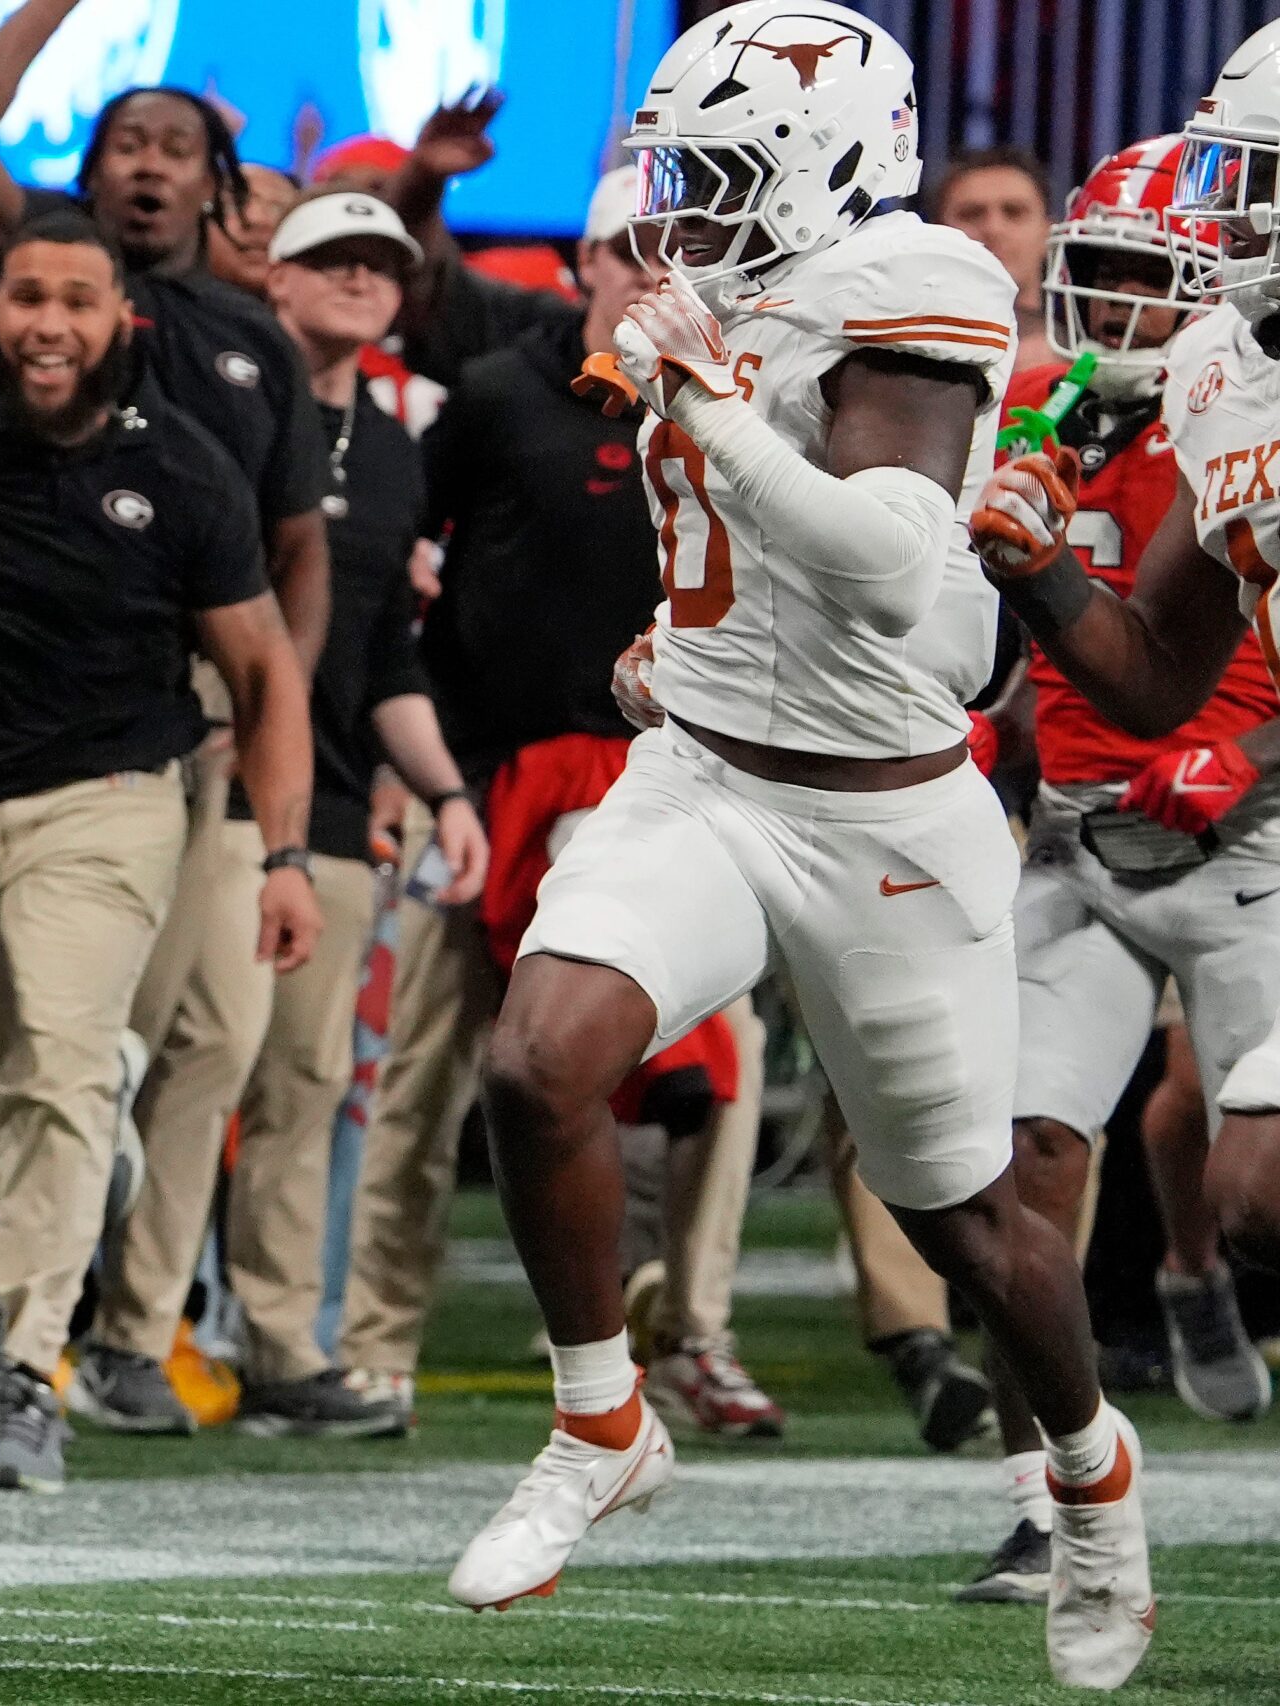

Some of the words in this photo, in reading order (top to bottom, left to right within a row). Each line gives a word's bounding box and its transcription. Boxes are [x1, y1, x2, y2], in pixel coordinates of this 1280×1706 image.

[1188, 362, 1224, 413] SEC
[1201, 436, 1280, 520] TEX
[102, 489, 154, 530] G
